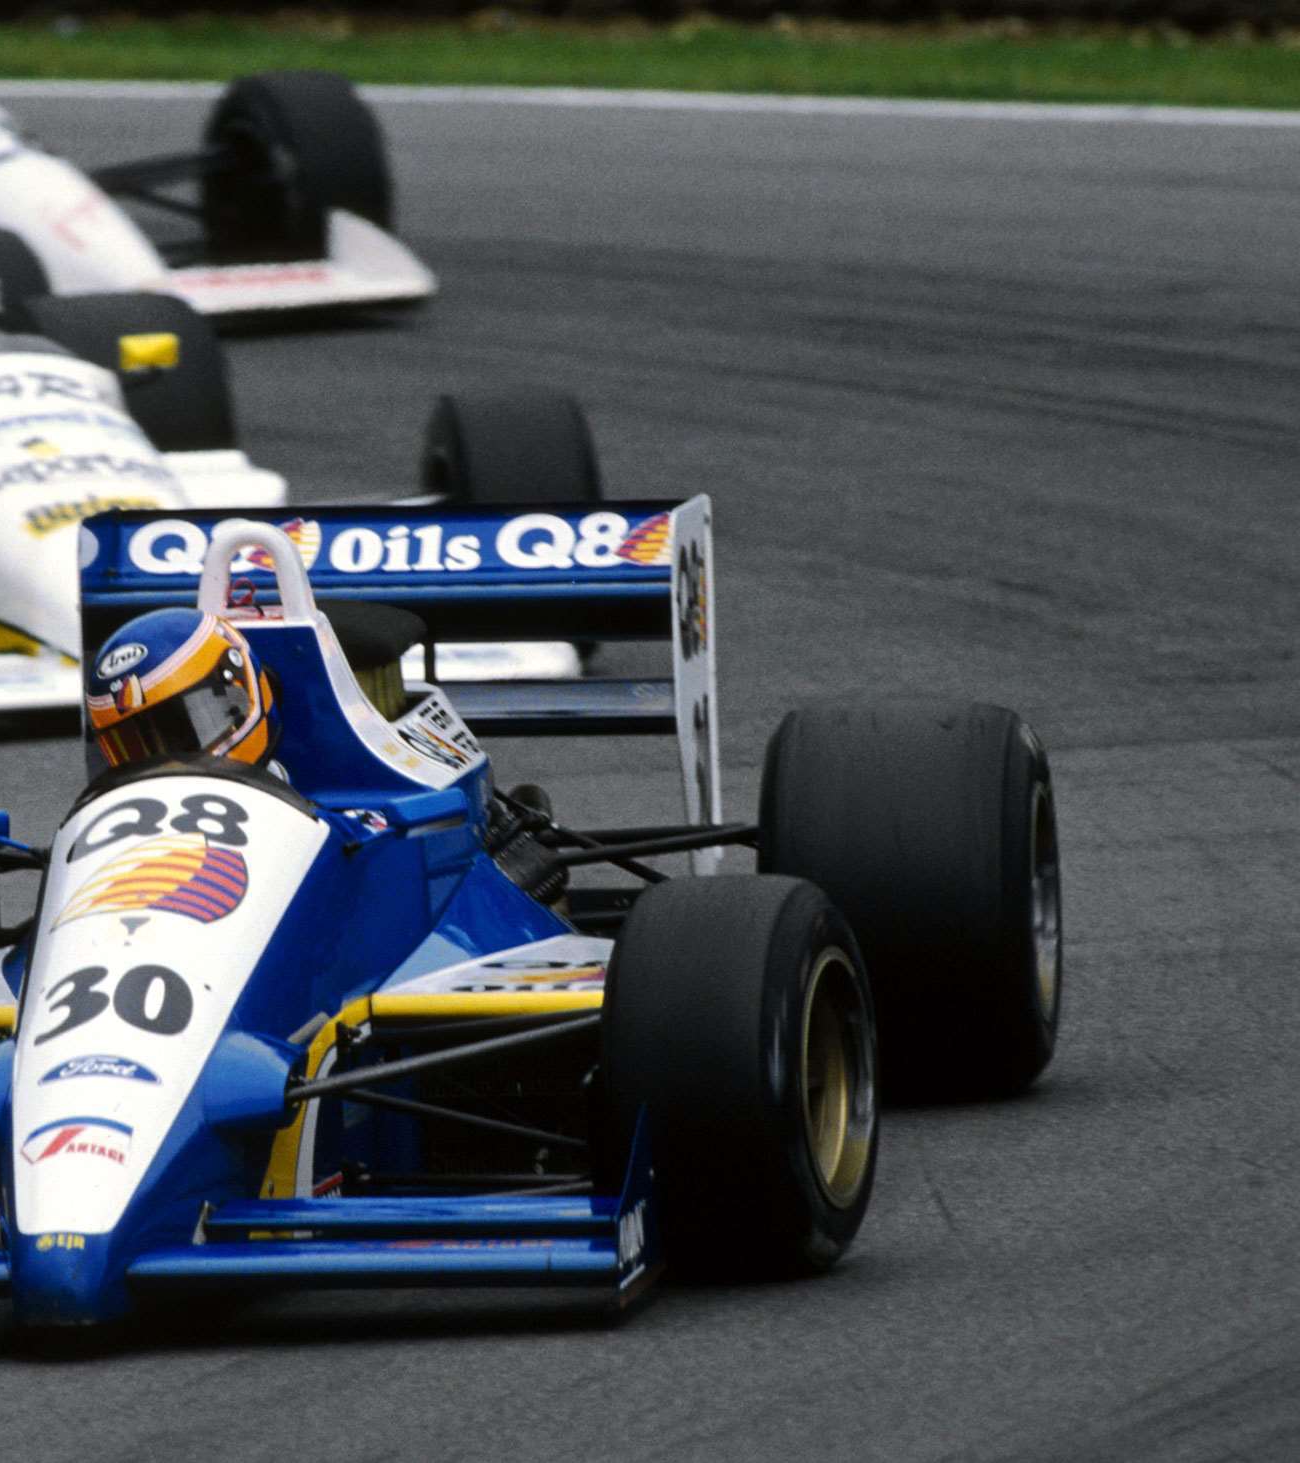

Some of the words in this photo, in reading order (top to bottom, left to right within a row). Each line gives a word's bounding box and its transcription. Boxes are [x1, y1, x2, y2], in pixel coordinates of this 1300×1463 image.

[128, 518, 260, 575] Q
[329, 524, 482, 572] Oils
[496, 511, 631, 569] Q8
[66, 792, 250, 864] Q8
[34, 964, 194, 1046] 30
[59, 1055, 138, 1078] Ford
